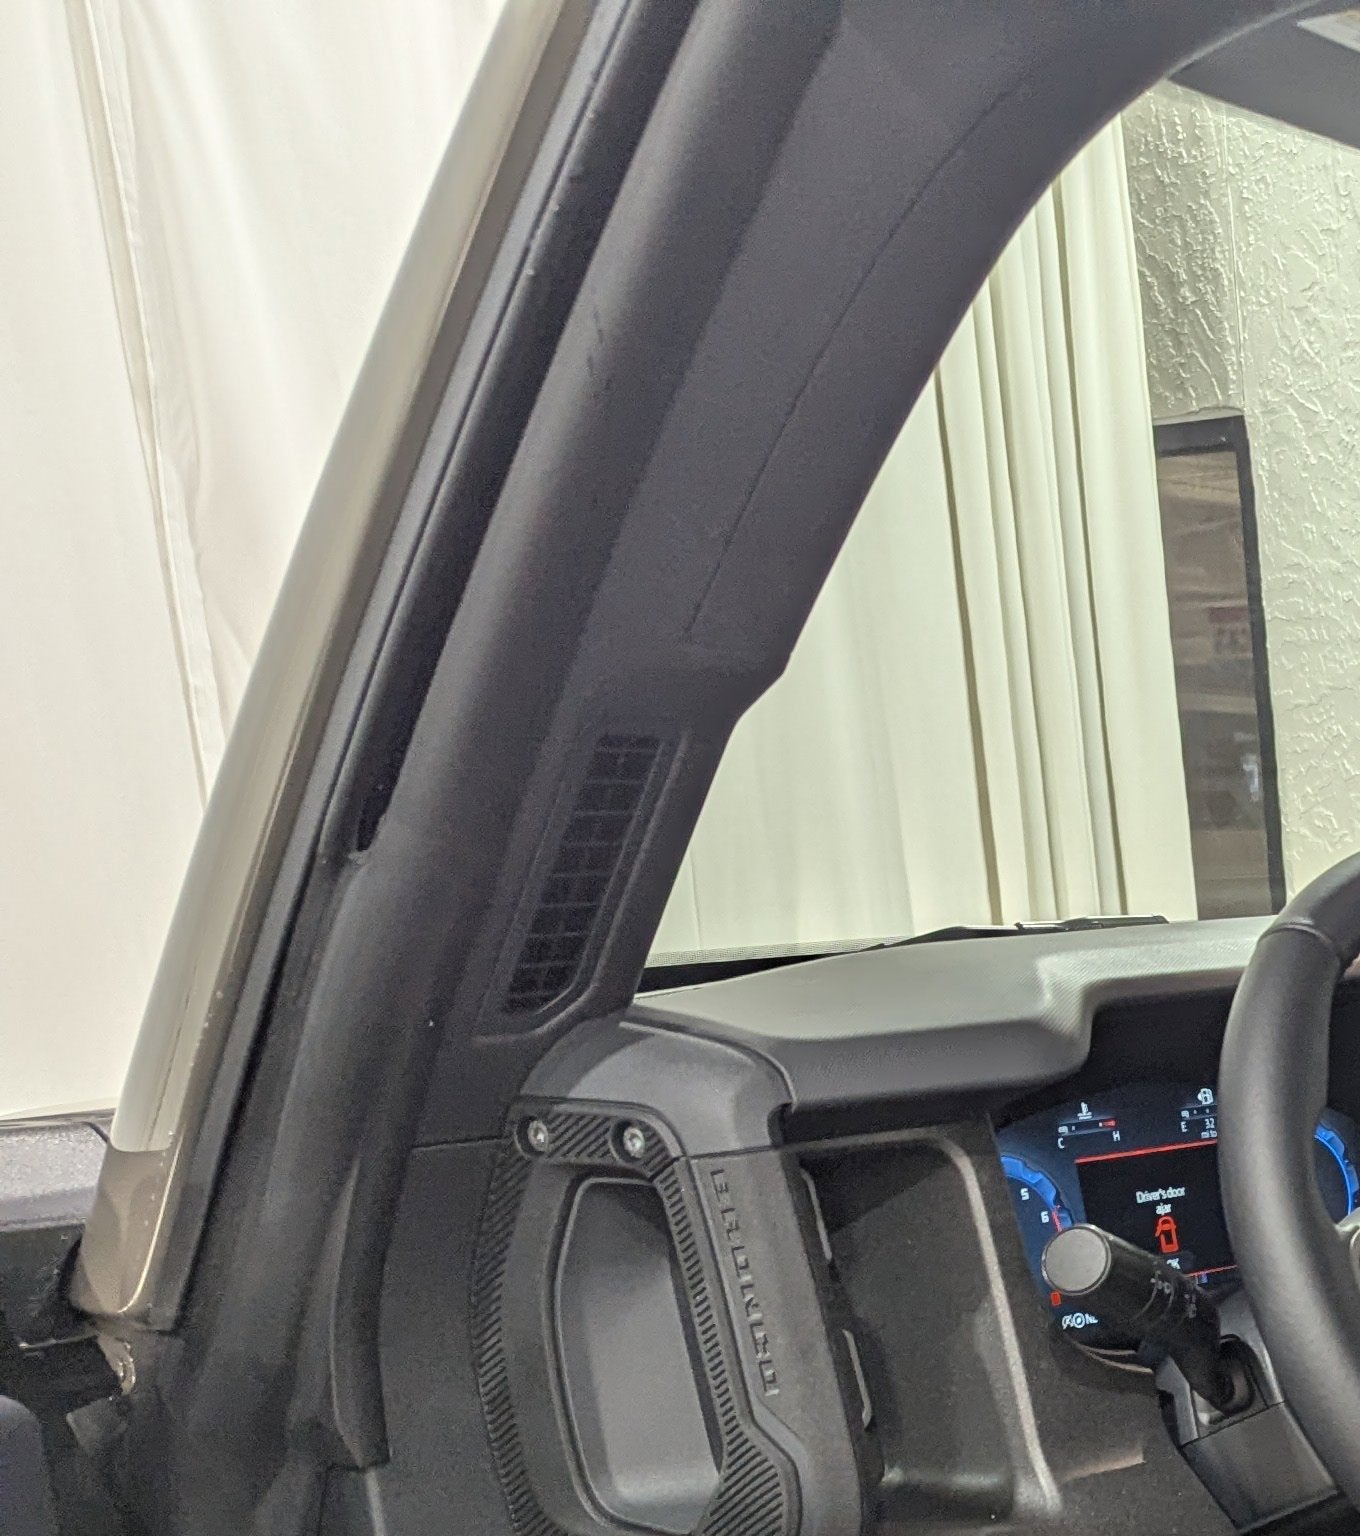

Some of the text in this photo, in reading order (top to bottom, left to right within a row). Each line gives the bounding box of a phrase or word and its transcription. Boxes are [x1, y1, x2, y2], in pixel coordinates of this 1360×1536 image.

[1180, 1118, 1215, 1133] E 32
[1057, 1130, 1121, 1149] C H
[1020, 1187, 1030, 1201] 5
[1136, 1185, 1186, 1204] Driver's door
[1155, 1202, 1172, 1216] ajar
[1041, 1211, 1050, 1223] 6
